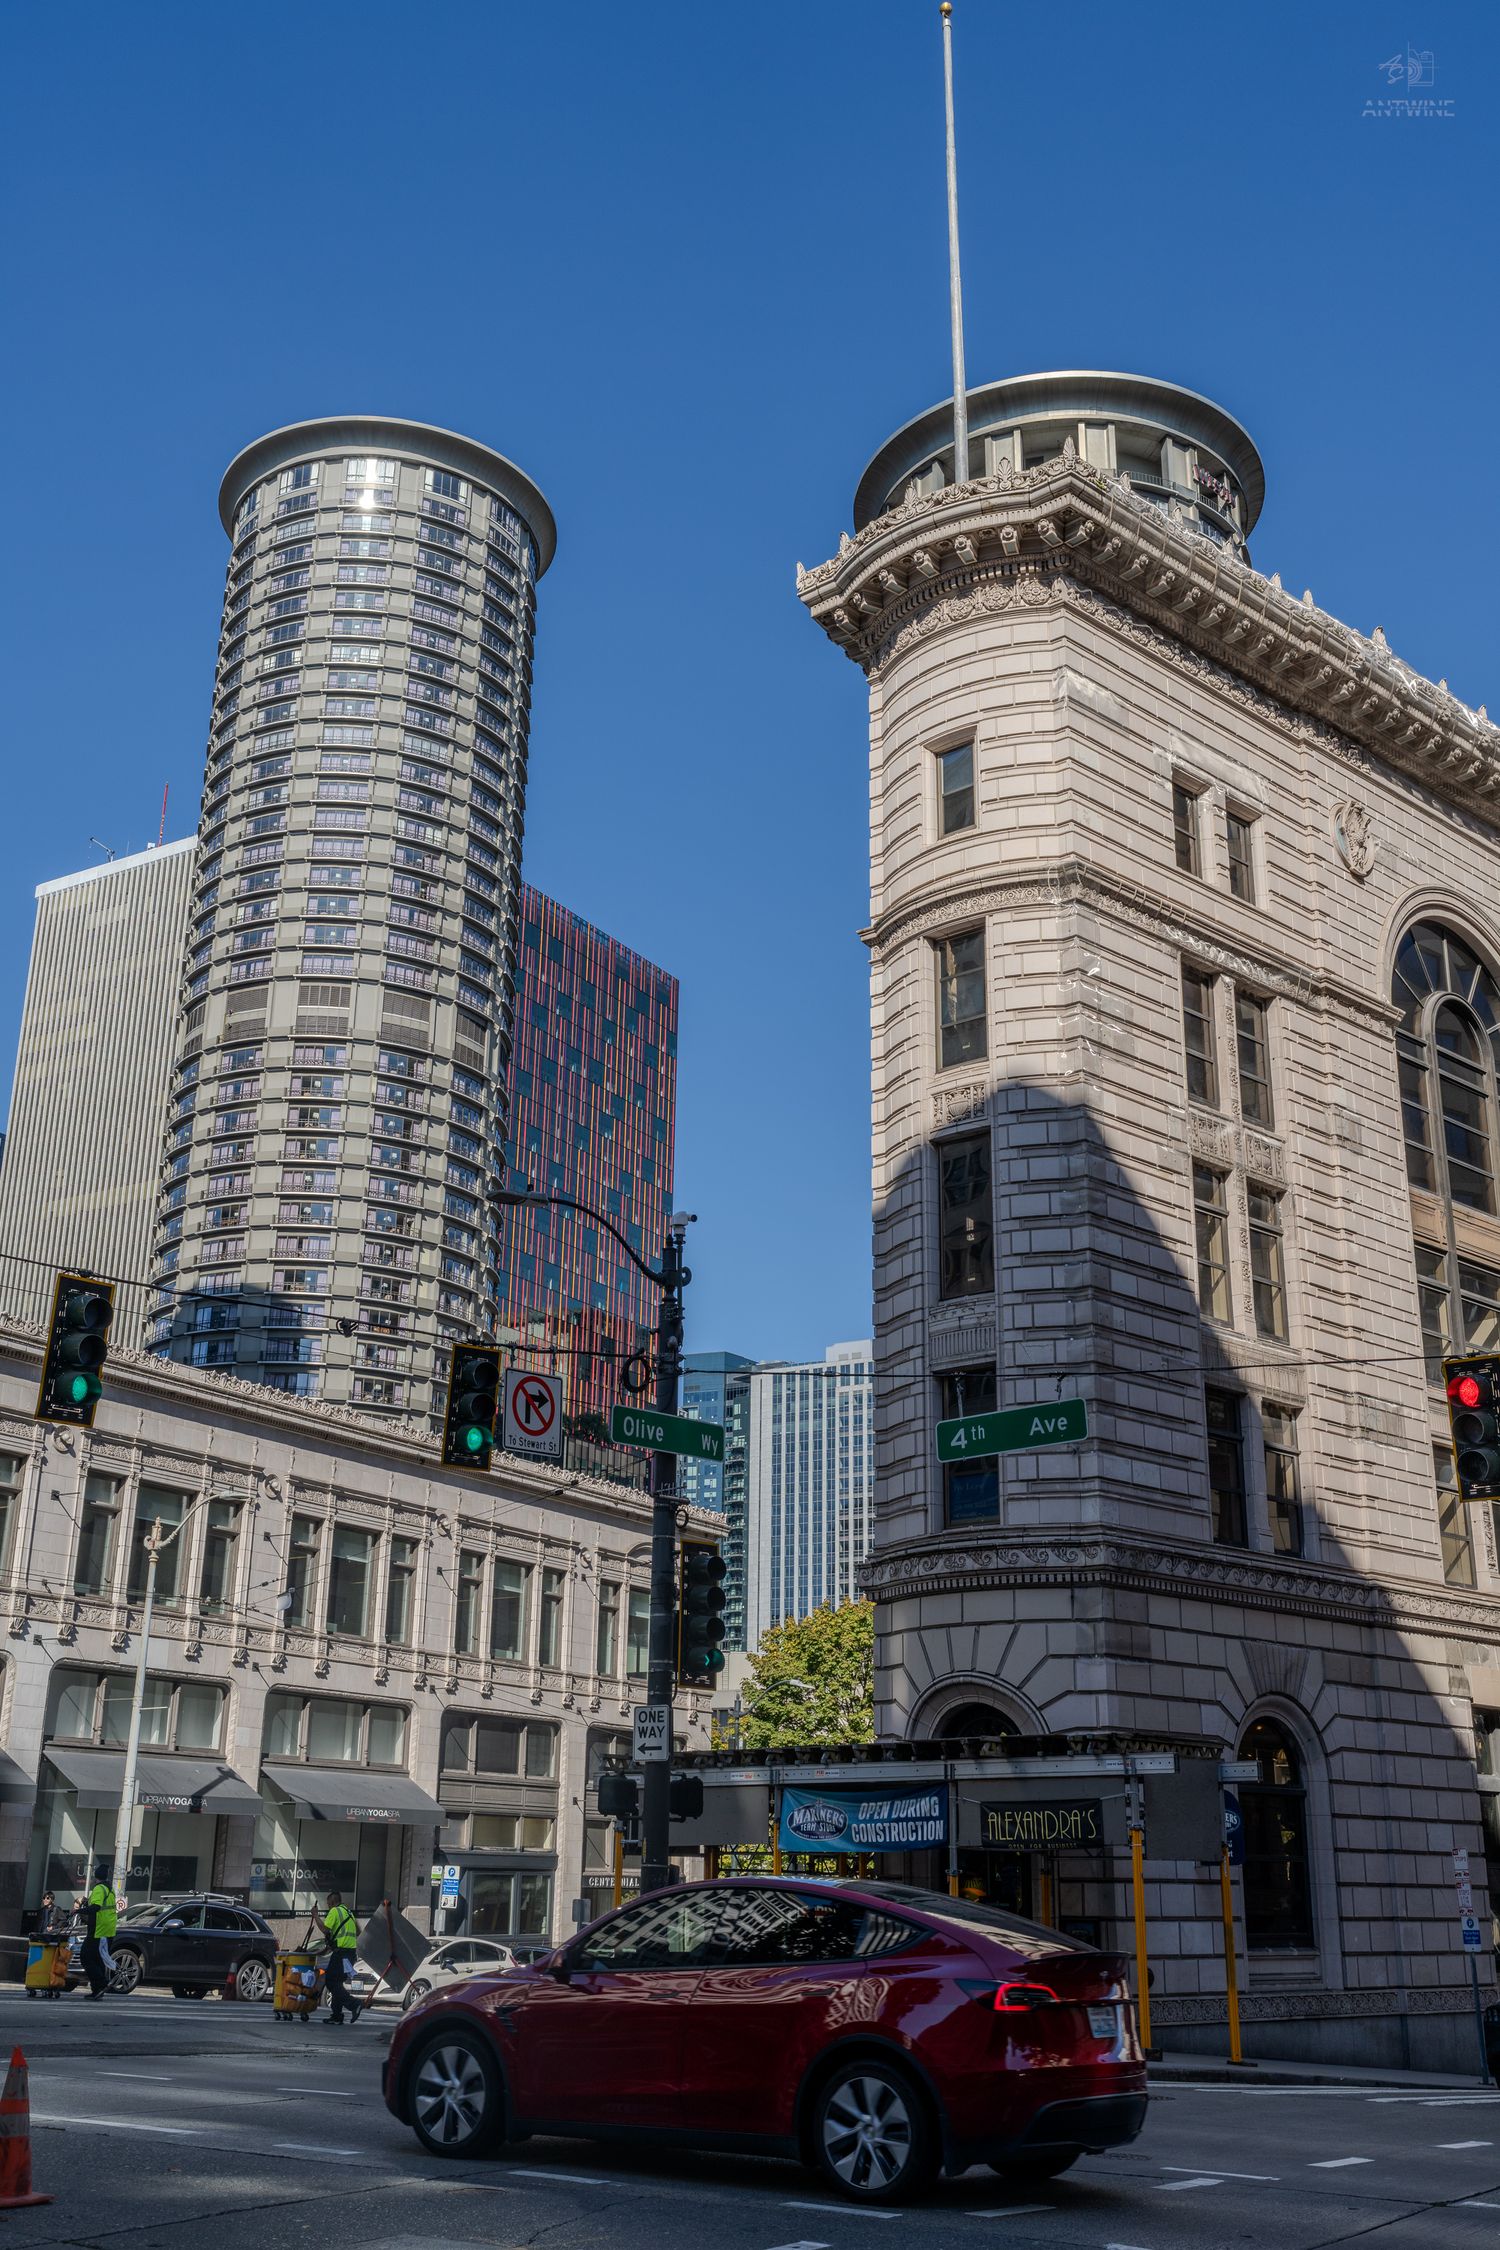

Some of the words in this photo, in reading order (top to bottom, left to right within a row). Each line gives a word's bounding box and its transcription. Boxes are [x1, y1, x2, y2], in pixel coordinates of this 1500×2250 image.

[623, 1415, 664, 1442] Olive
[701, 1433, 719, 1455] Wy
[950, 1425, 986, 1449] 4th
[1029, 1416, 1068, 1437] Ave
[508, 1434, 518, 1446] To
[518, 1435, 547, 1451] Stewart
[548, 1441, 557, 1453] St
[638, 1710, 665, 1724] ONE
[637, 1725, 666, 1739] WAY
[793, 1807, 845, 1828] MARINERS
[858, 1801, 891, 1820] OPEN
[891, 1796, 939, 1819] DURING
[800, 1822, 817, 1832] TEAM
[851, 1820, 944, 1843] CONSTRUCTION
[987, 1809, 1097, 1841] ALEXANDRA'S
[588, 1876, 640, 1888] CENTENIAL
